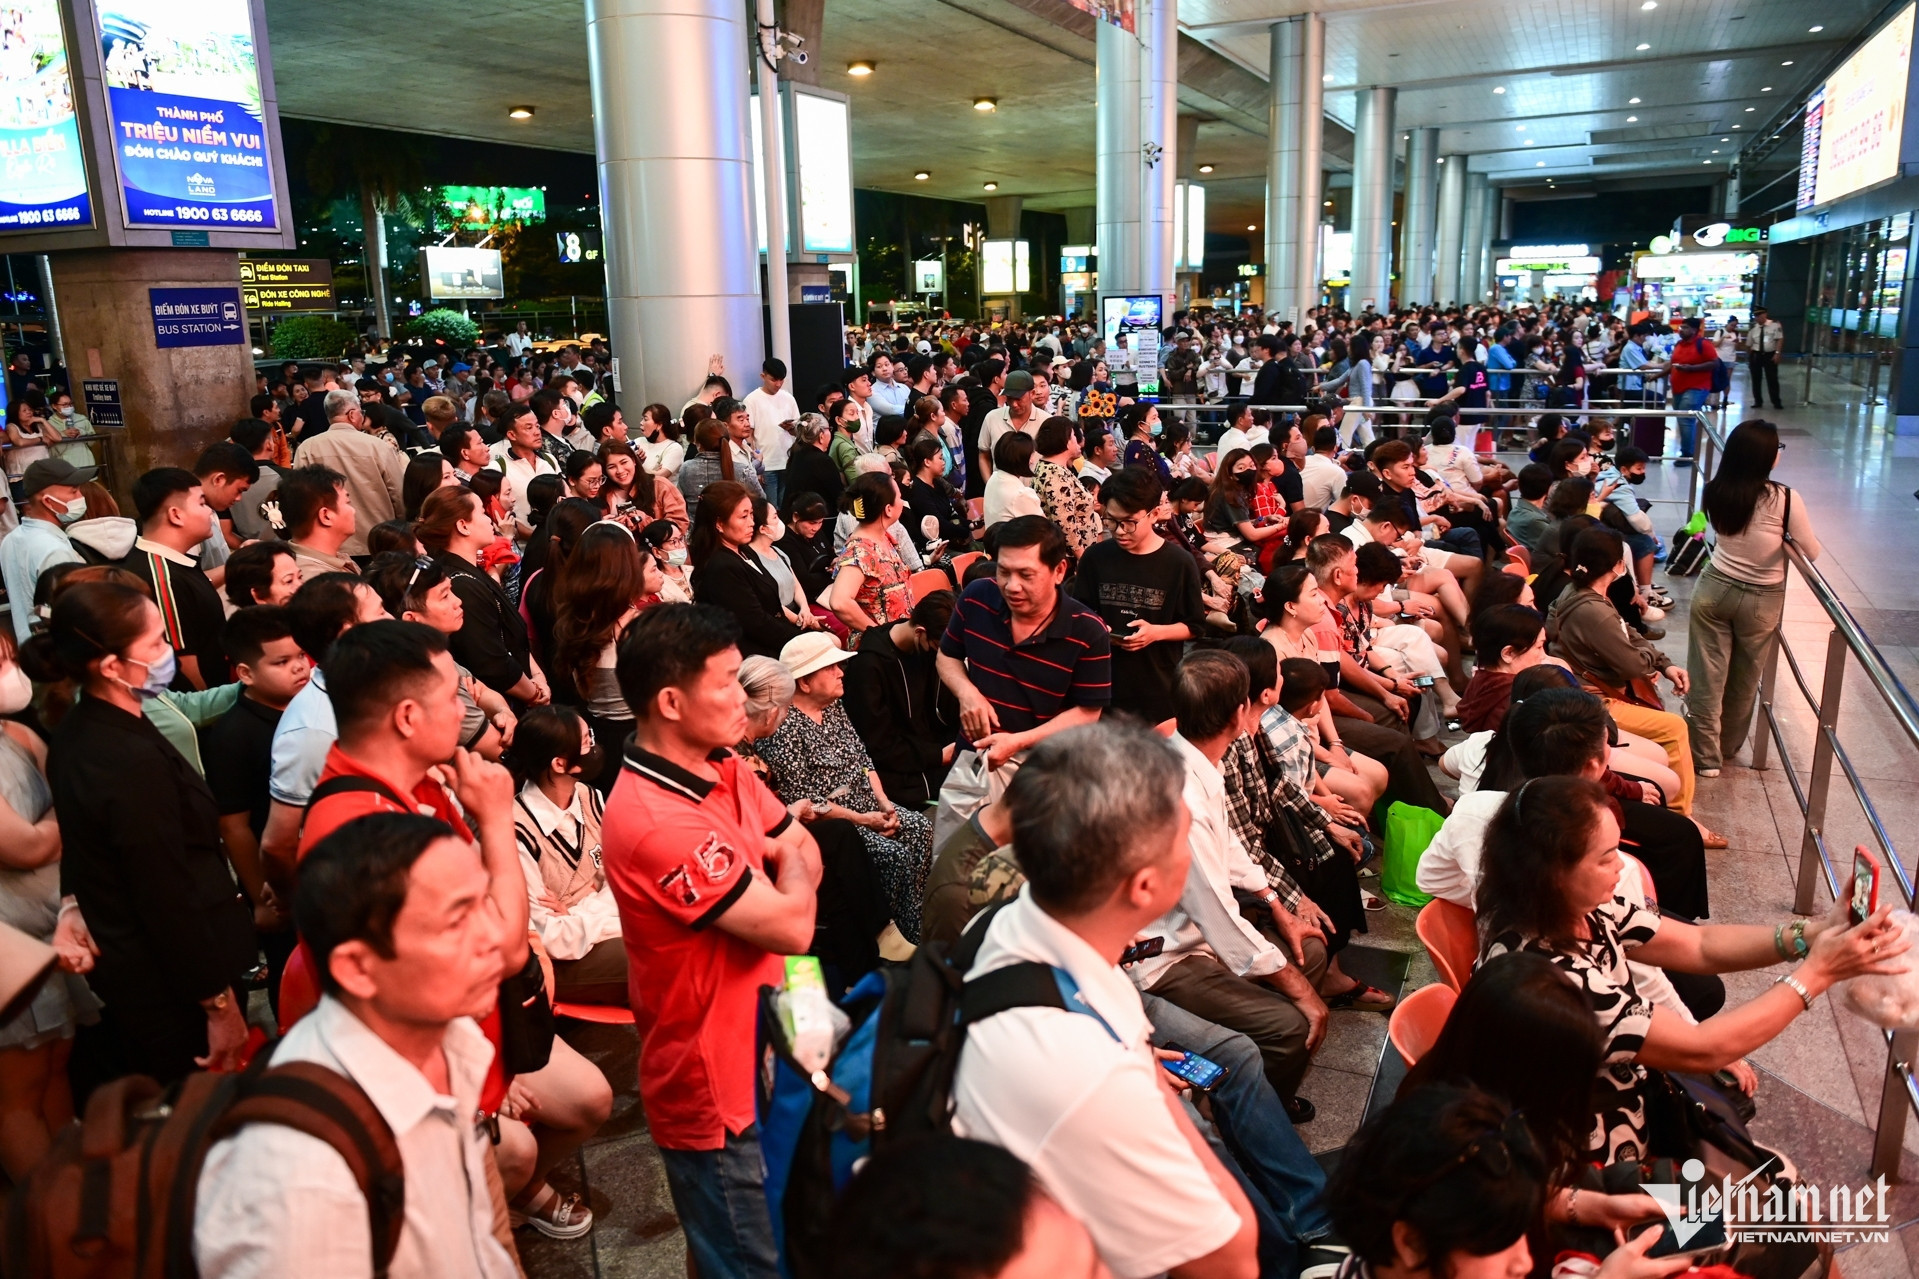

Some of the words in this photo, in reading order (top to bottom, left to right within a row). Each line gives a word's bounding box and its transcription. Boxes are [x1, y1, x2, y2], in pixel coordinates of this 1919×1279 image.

[156, 106, 198, 121] THÀNH
[199, 110, 224, 123] PHỐ
[120, 121, 178, 144] TRIỆU
[182, 124, 227, 146] NIỀM
[230, 132, 261, 149] VUI
[124, 144, 154, 159] ĐÓN
[156, 147, 191, 162] CHÀO
[193, 150, 218, 164] QUÝ
[187, 185, 216, 194] LAND
[18, 209, 41, 224] 1900
[42, 208, 55, 222] 63
[55, 207, 80, 221] 6666
[143, 208, 175, 217] HOTLINE
[175, 206, 209, 220] 1900
[211, 208, 228, 221] 63
[230, 209, 262, 222] 6666
[1726, 228, 1758, 242] BIG
[565, 233, 582, 261] 8
[585, 249, 598, 260] GF
[276, 264, 292, 272] ĐÓN
[293, 264, 309, 272] TAXI
[1066, 256, 1076, 272] 9
[1238, 264, 1252, 276] 10
[260, 290, 277, 299] ĐÓN
[277, 291, 288, 299] XE
[288, 290, 310, 298] CÔNG
[155, 302, 174, 316] ĐIỂM
[174, 303, 190, 315] ĐÓN
[190, 304, 200, 315] XE
[201, 302, 218, 314] BUÝT
[157, 325, 180, 335] BUS
[181, 323, 222, 333] STATION
